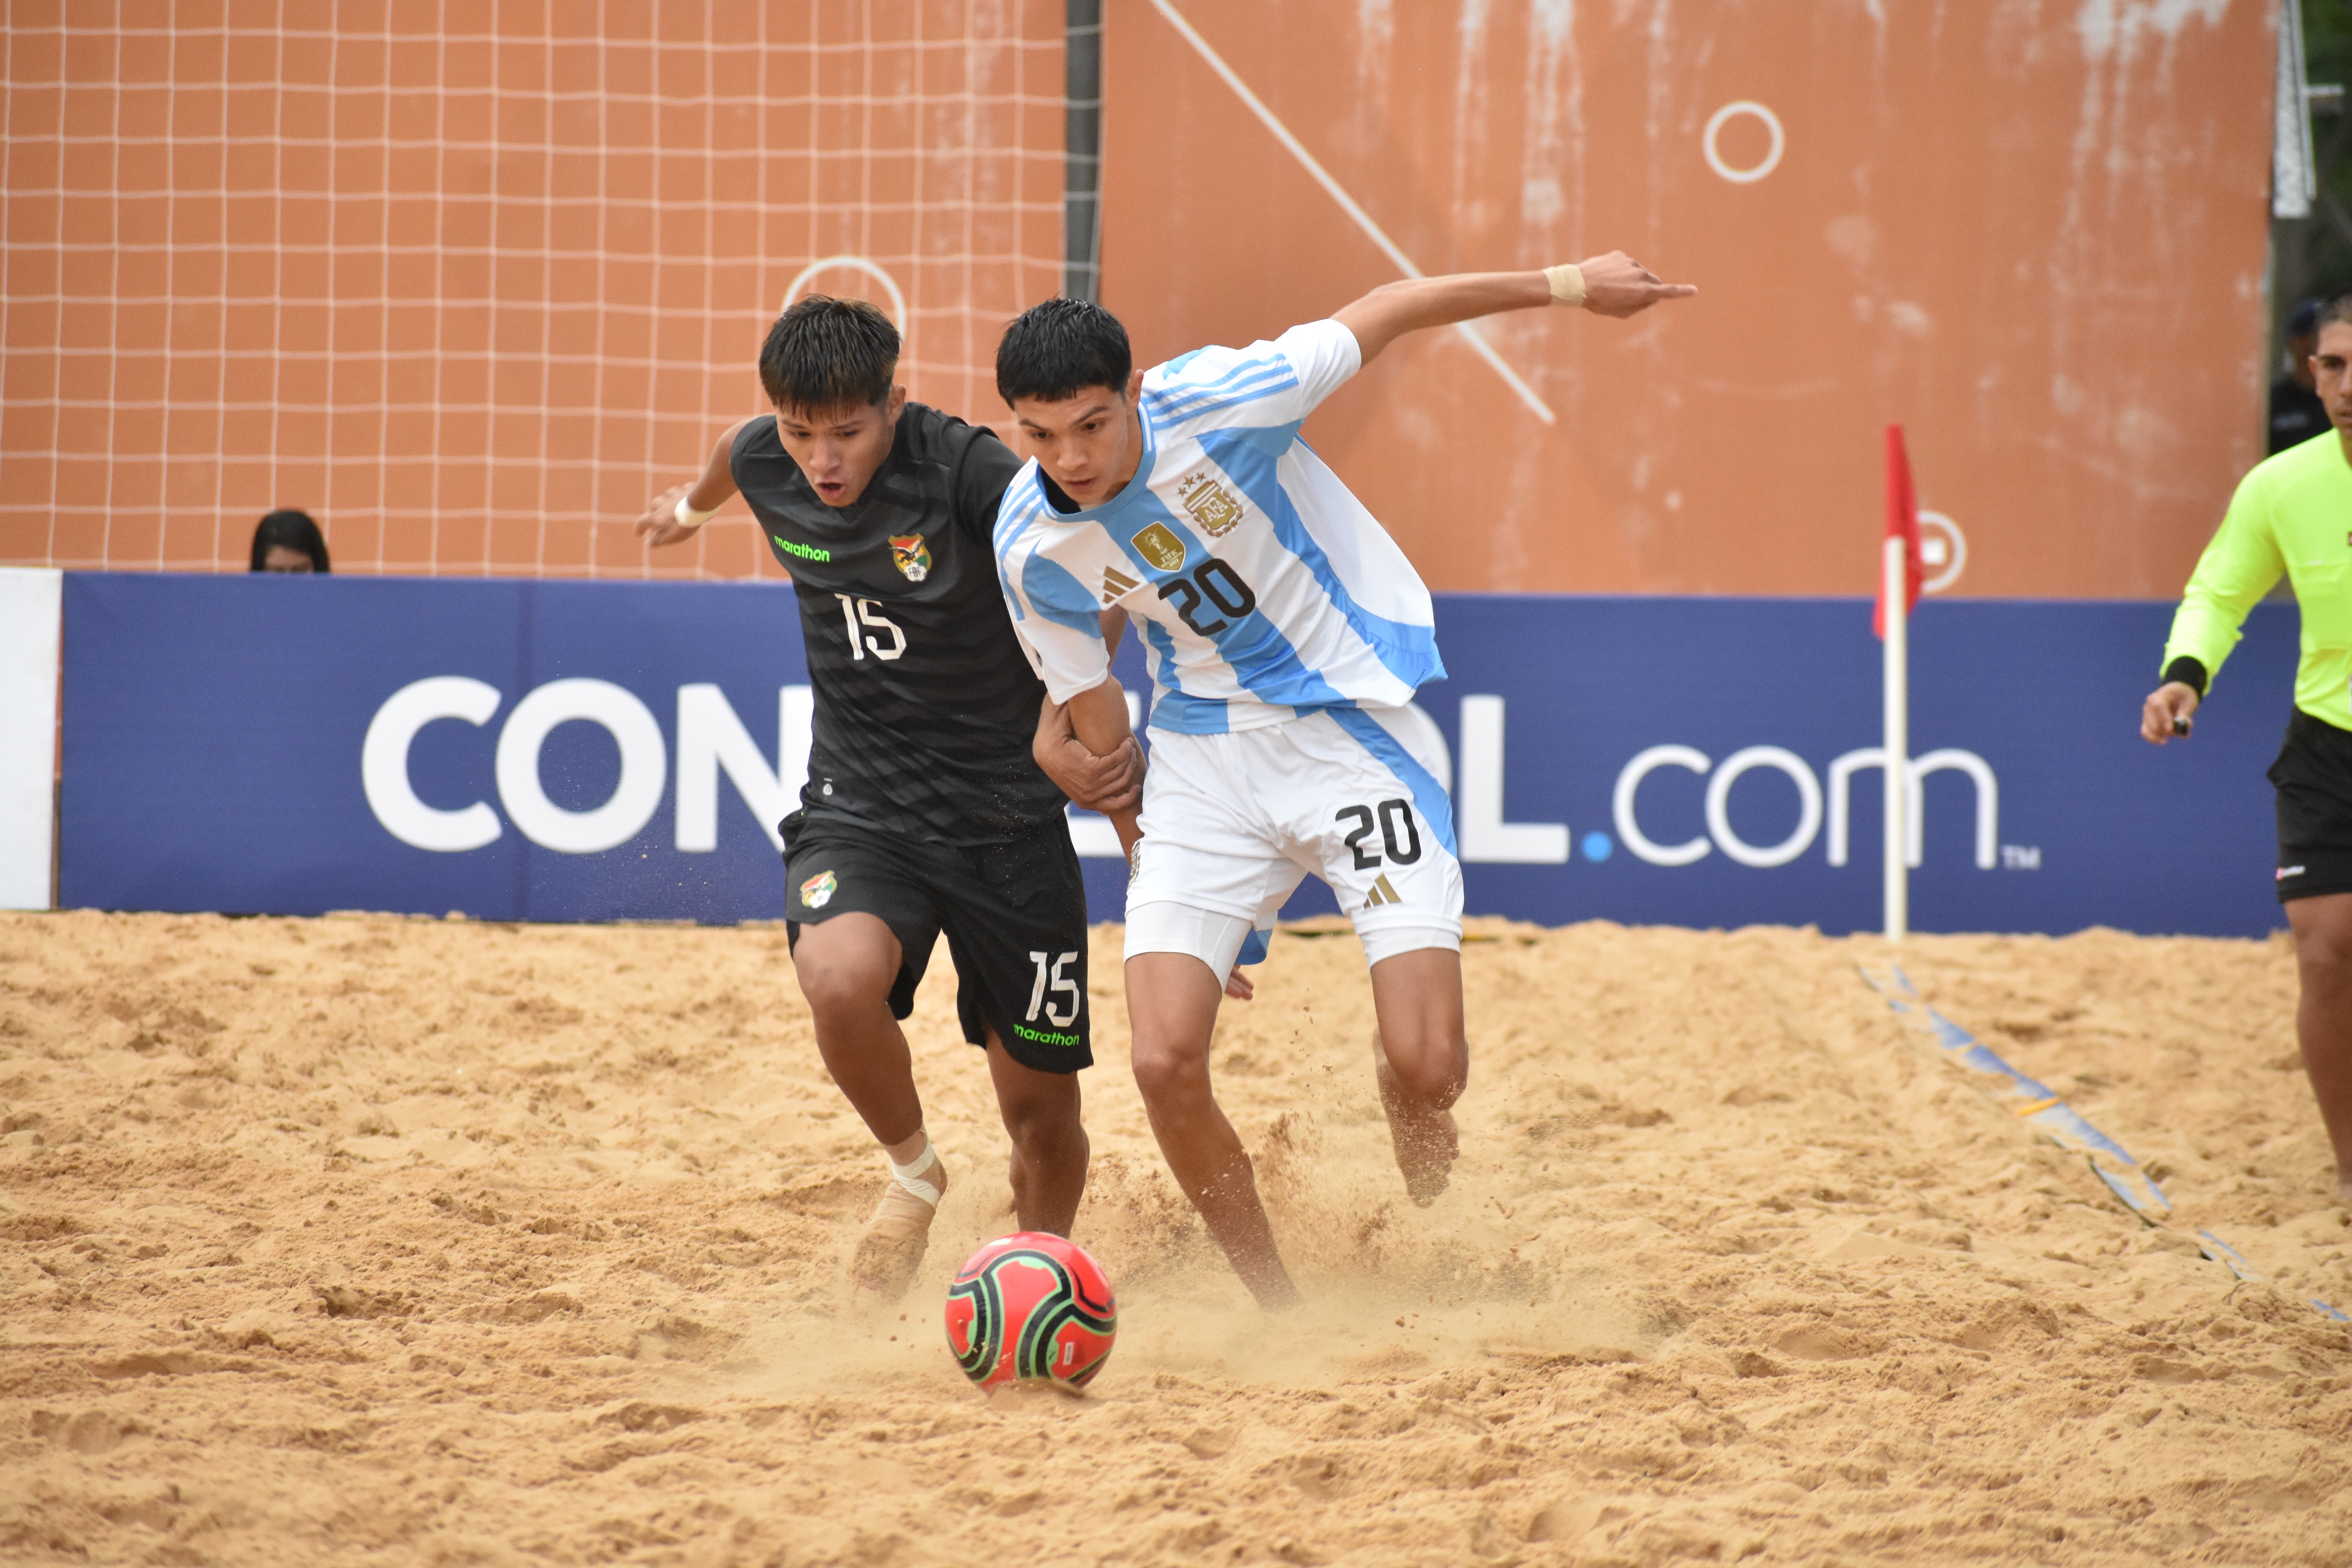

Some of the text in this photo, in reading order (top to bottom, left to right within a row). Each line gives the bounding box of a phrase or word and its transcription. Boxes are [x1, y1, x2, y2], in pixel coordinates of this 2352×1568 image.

[1202, 497, 1228, 522] AFA
[774, 535, 829, 562] marathon
[1160, 550, 1178, 563] FIFA
[1158, 558, 1256, 636] 20
[835, 593, 906, 660] 15
[1335, 799, 1421, 871] 20
[1026, 951, 1079, 1027] 15
[1013, 1024, 1079, 1046] marathon
